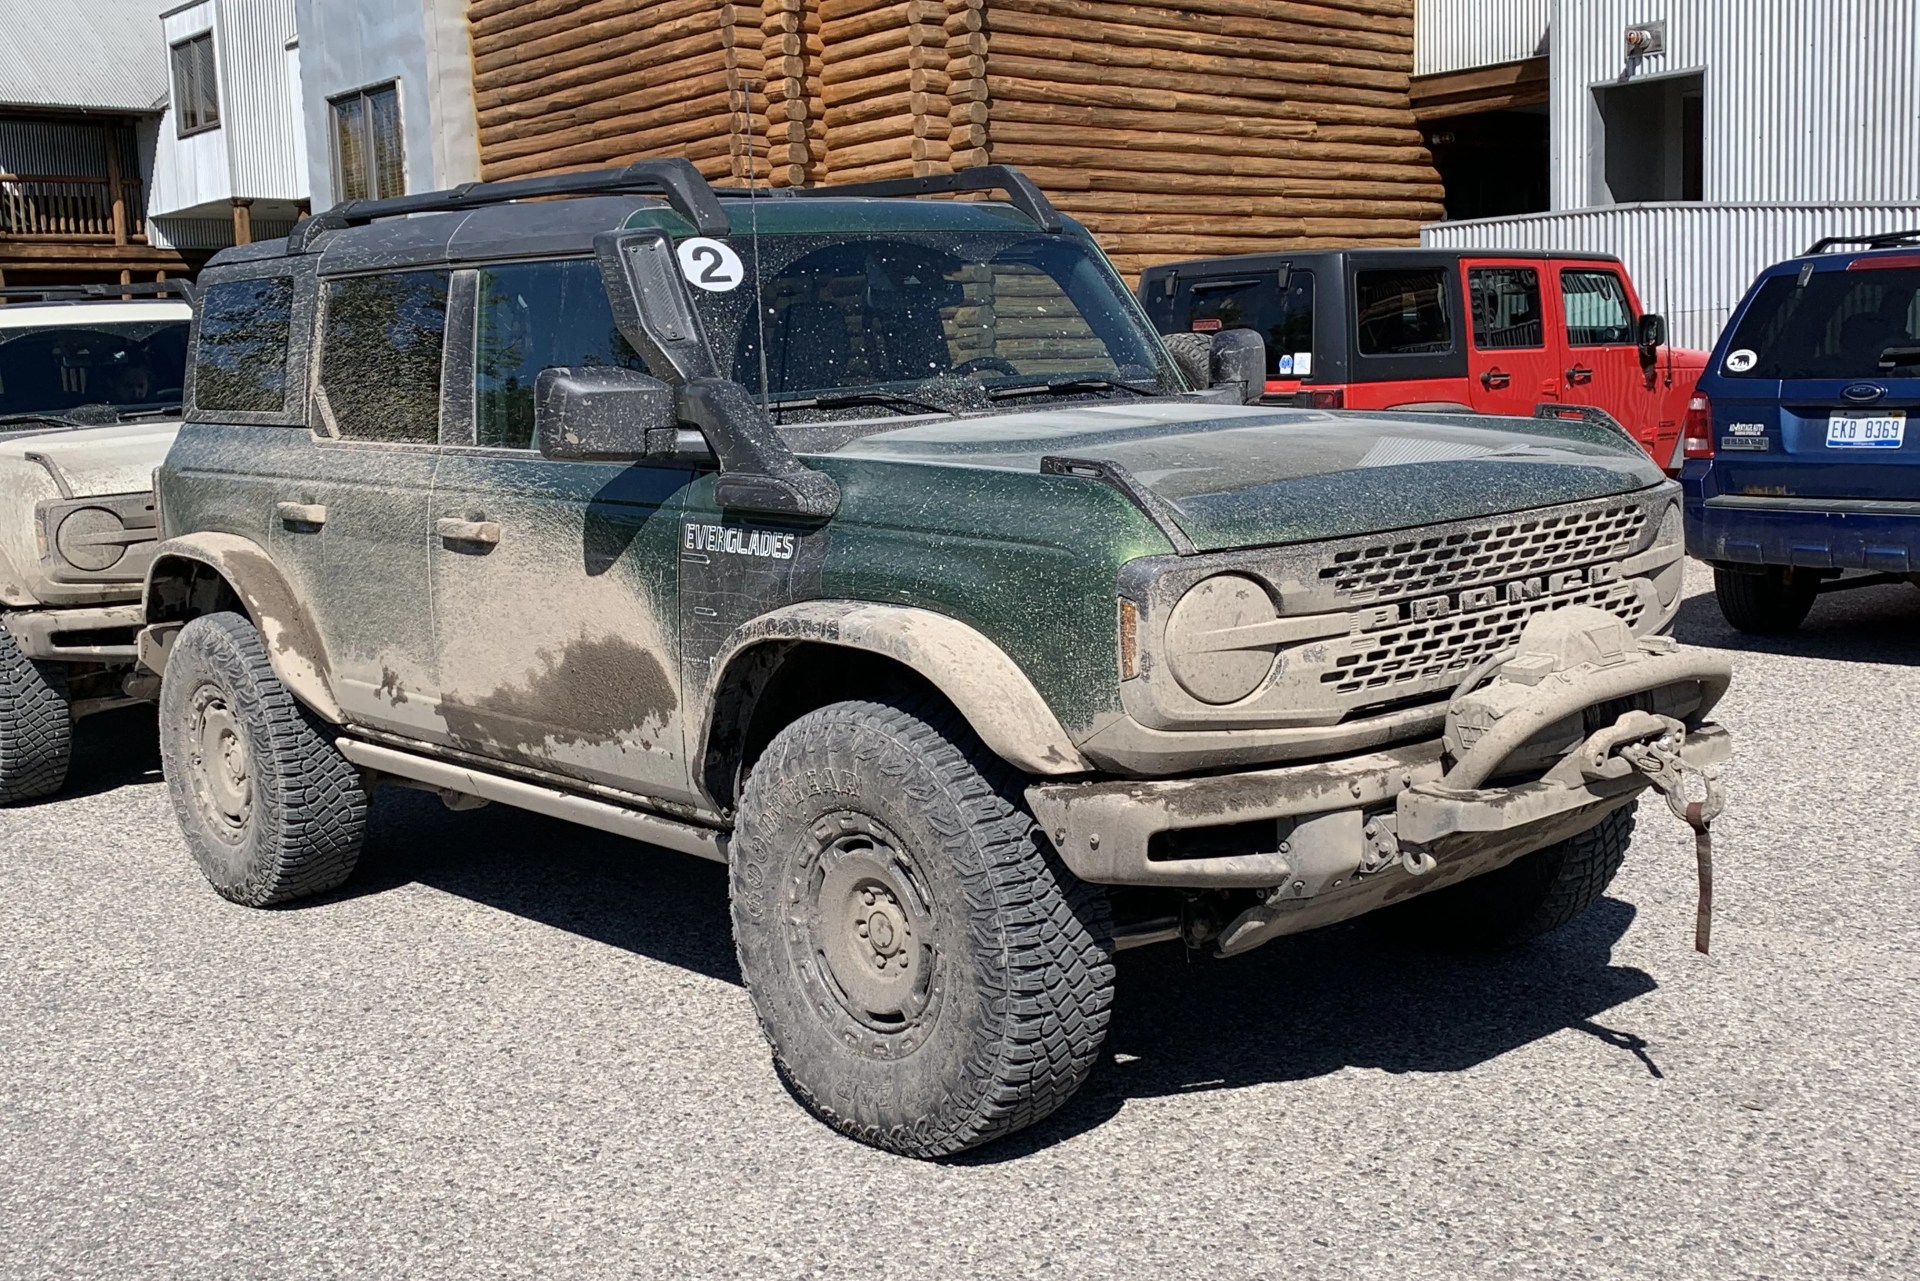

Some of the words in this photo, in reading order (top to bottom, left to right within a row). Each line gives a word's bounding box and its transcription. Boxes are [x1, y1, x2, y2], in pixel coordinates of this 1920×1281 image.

[692, 246, 732, 283] 2
[1831, 421, 1857, 439] EKB
[1865, 421, 1900, 439] 8369
[684, 523, 795, 560] EVERGLADES
[1358, 561, 1621, 633] BRONCO
